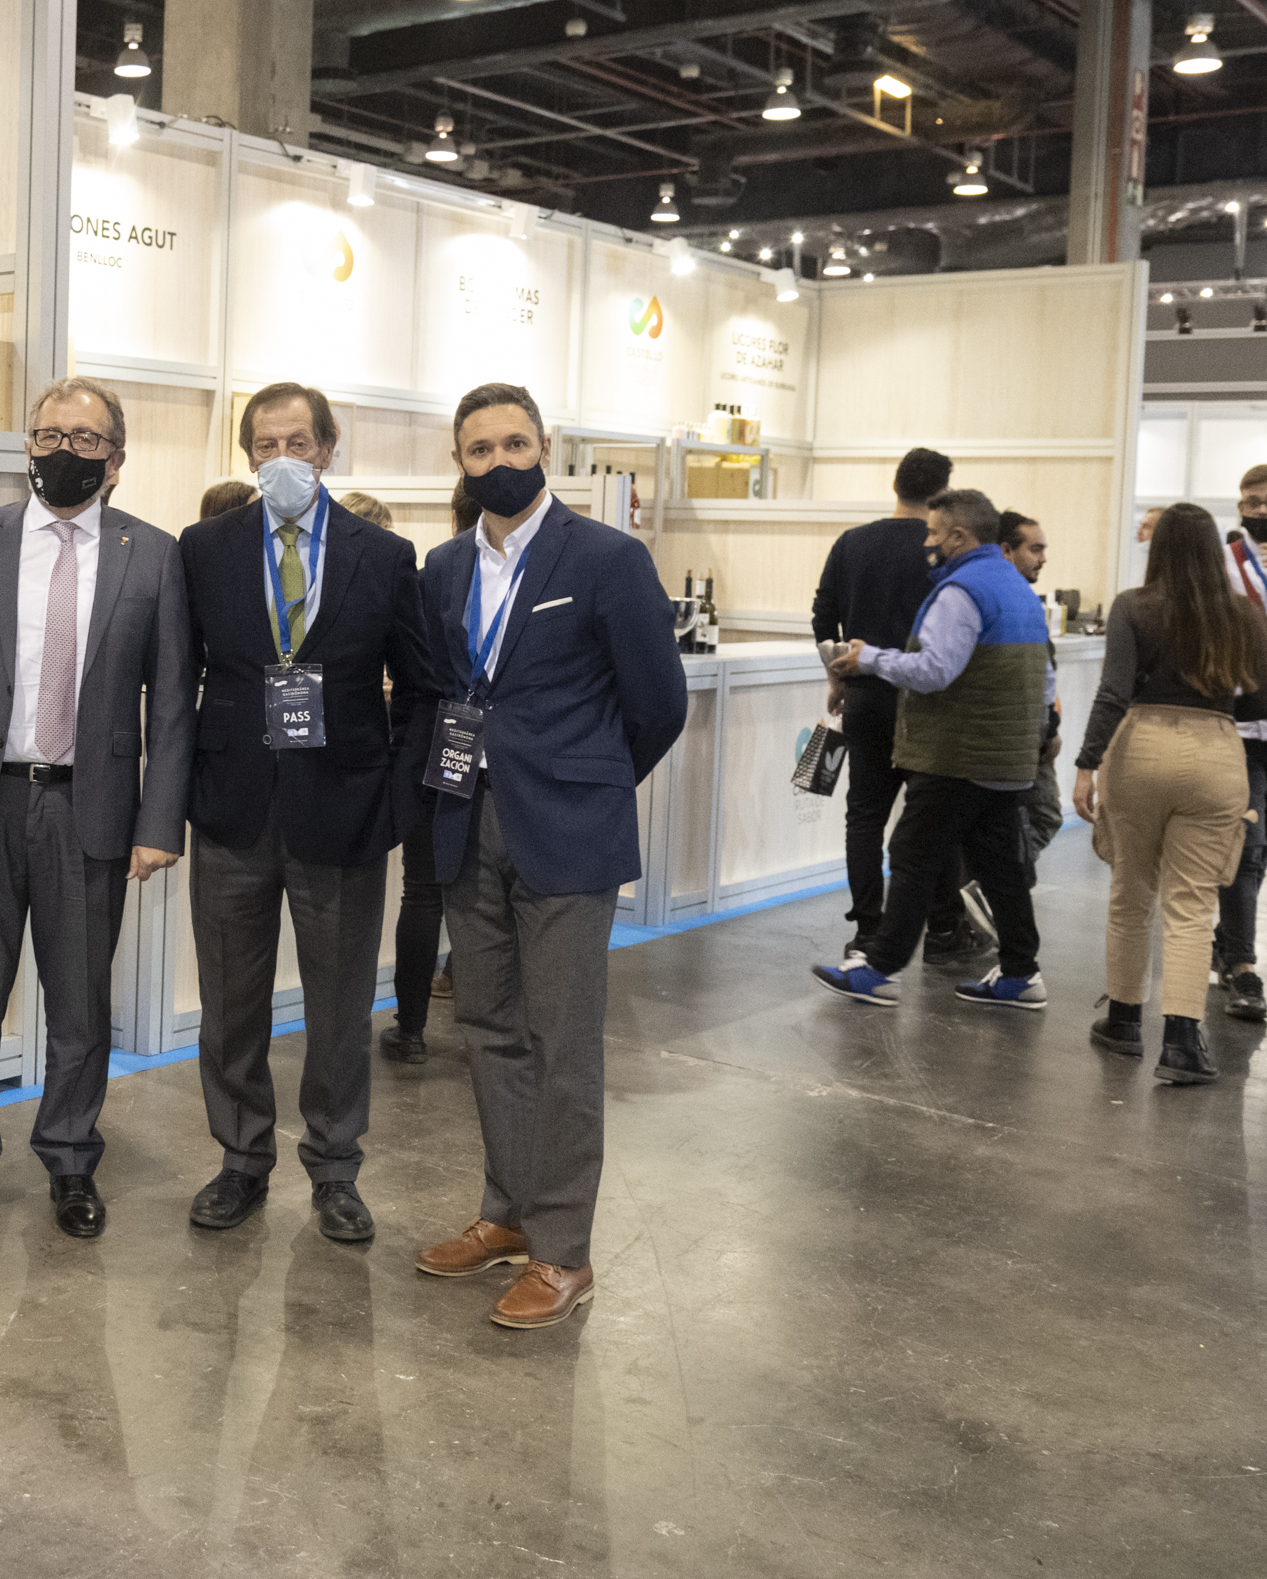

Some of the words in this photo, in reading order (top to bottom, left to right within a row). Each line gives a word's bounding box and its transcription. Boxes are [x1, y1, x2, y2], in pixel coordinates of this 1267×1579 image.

[70, 214, 122, 241] ONES
[127, 224, 177, 251] AGUT
[77, 250, 123, 268] BENLLOC
[768, 339, 790, 357] FLOR
[736, 351, 748, 366] DE
[750, 354, 785, 373] AZAHAR
[283, 710, 311, 723] PASS
[442, 747, 473, 764] ORGANI
[439, 757, 471, 774] ZACIÓN
